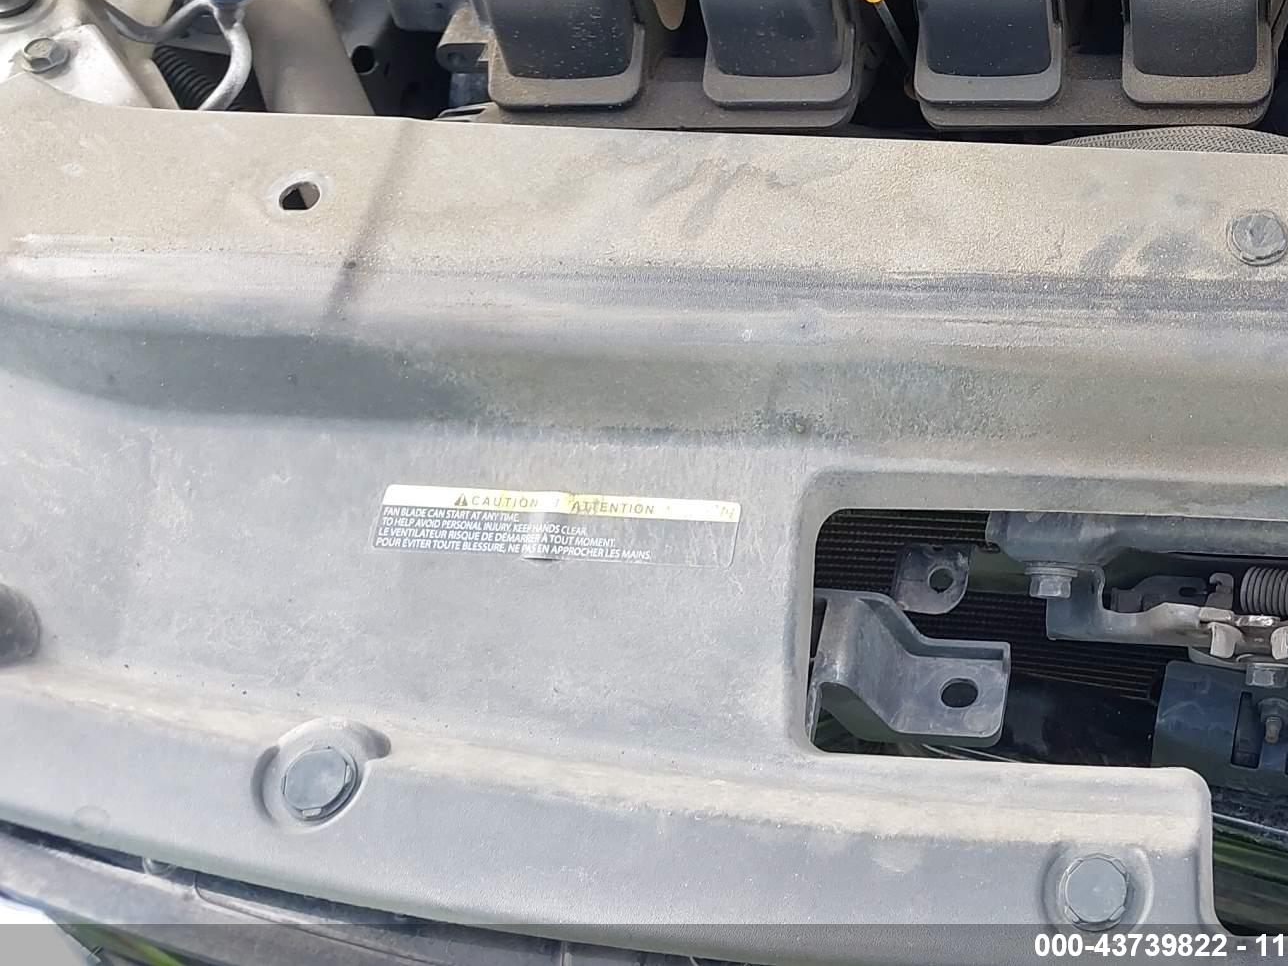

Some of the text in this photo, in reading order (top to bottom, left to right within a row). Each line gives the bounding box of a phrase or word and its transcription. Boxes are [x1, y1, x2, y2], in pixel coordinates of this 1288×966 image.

[383, 507, 400, 516] FAN
[400, 508, 427, 518] BLADE
[427, 509, 446, 519] CAN
[445, 510, 471, 520] START
[470, 511, 482, 520] AT
[482, 512, 500, 522] ANY
[472, 496, 539, 508] CAUTION
[570, 500, 655, 514] ATTENTION
[382, 517, 394, 526] TO
[394, 518, 414, 528] HELP
[414, 519, 441, 529] AVOID
[442, 520, 484, 531] PERSONAL
[512, 523, 533, 533] KEEP
[533, 524, 560, 534] HANDS
[561, 525, 588, 536] CLEAR.
[378, 527, 389, 536] LE
[390, 528, 447, 540] VENTILATEUR
[448, 530, 480, 541] RISQUE
[480, 532, 494, 542] DE
[550, 536, 574, 546] TOUT
[574, 536, 616, 548] MOMENT.
[376, 537, 652, 560] POUR ÉVITER TOUTE BLESSURE, NE PAS EN APPROCHER LES MAINS.
